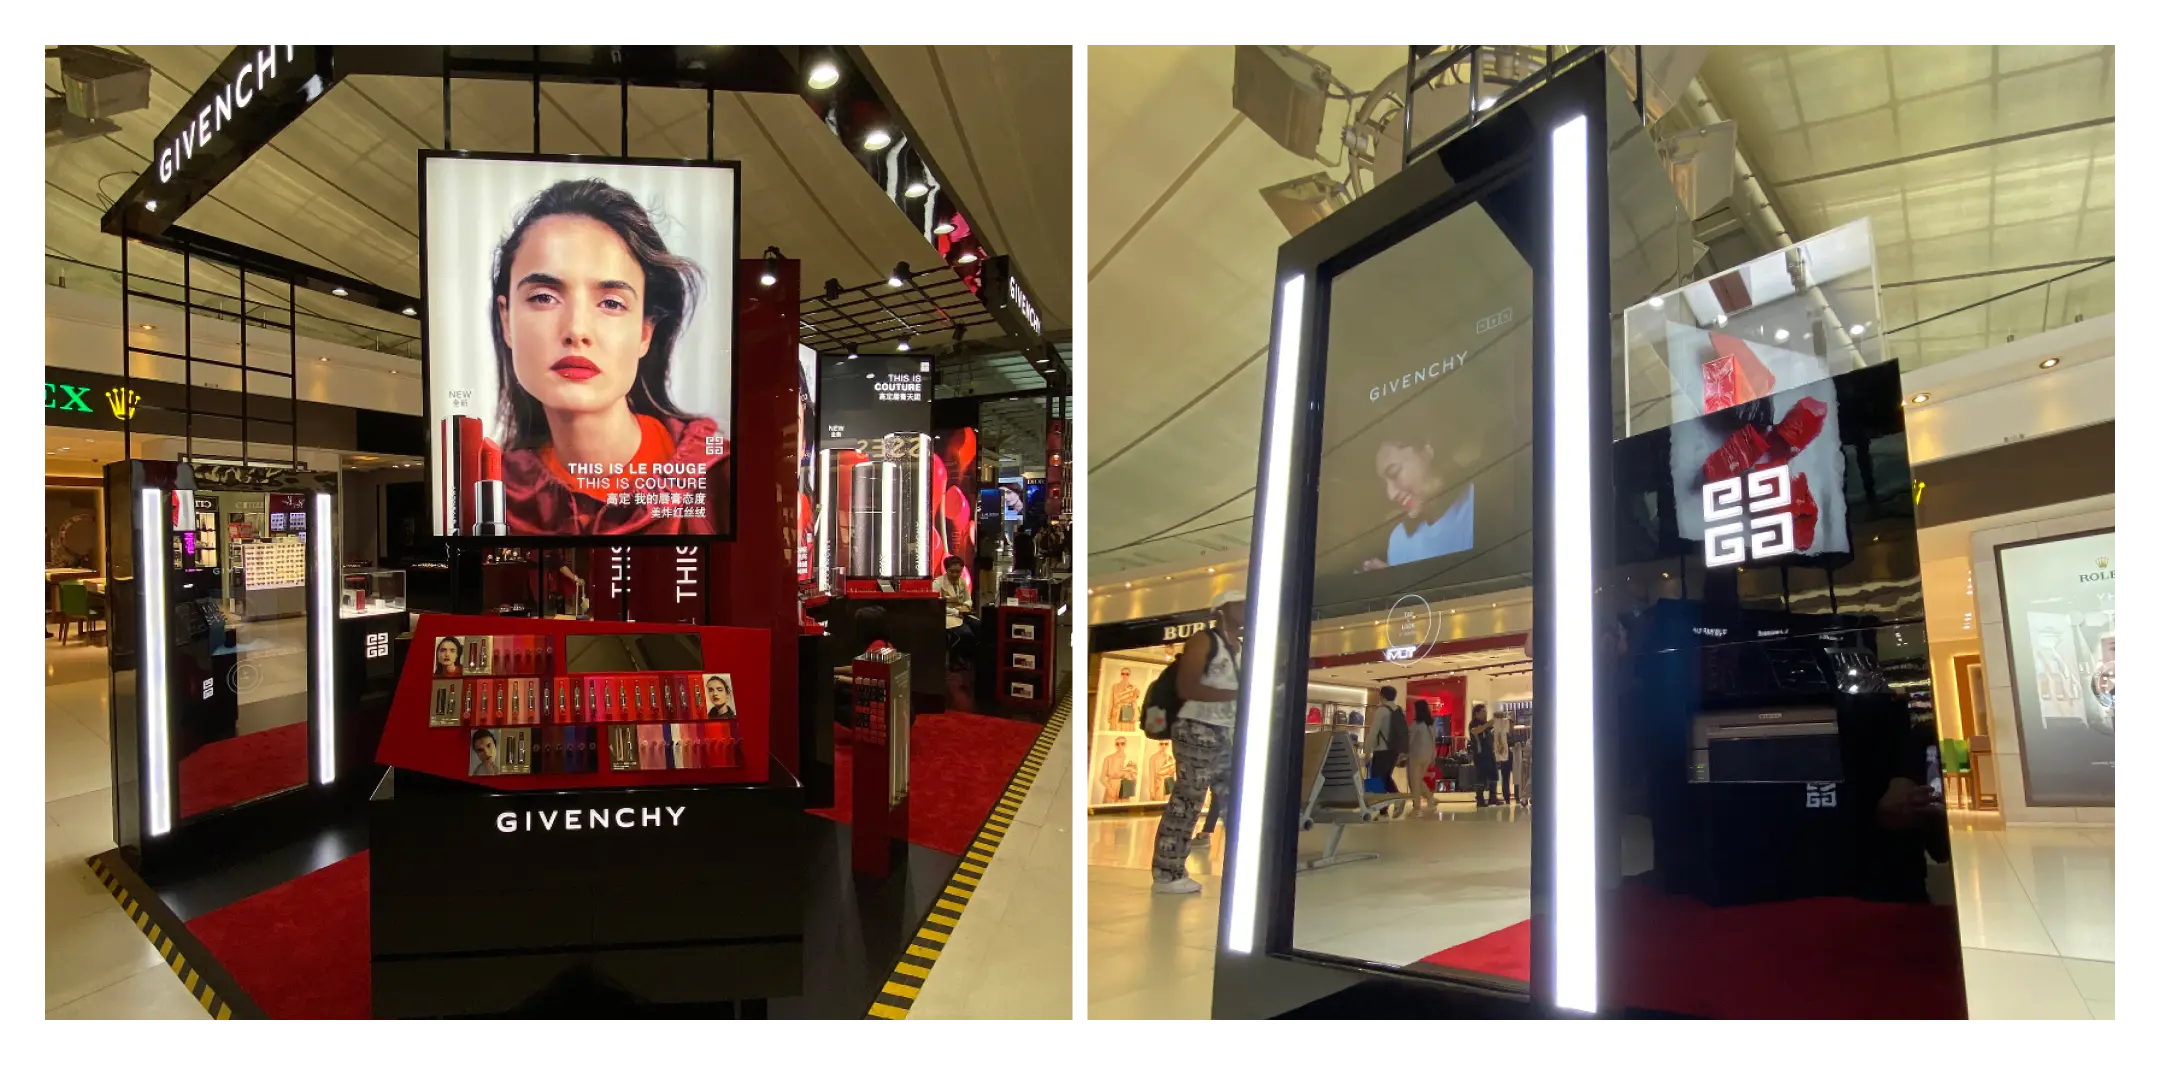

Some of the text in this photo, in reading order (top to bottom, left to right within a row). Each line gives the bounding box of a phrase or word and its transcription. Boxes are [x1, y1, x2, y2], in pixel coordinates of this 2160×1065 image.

[888, 373, 922, 382] THIS IS
[1369, 351, 1468, 401] GIVENCHY
[874, 383, 922, 392] COUTURE
[448, 390, 472, 399] NEW
[568, 462, 707, 475] THIS IS LE ROUGE
[577, 477, 707, 490] THIS IS COUTURE
[496, 806, 686, 833] GIVENCHY
